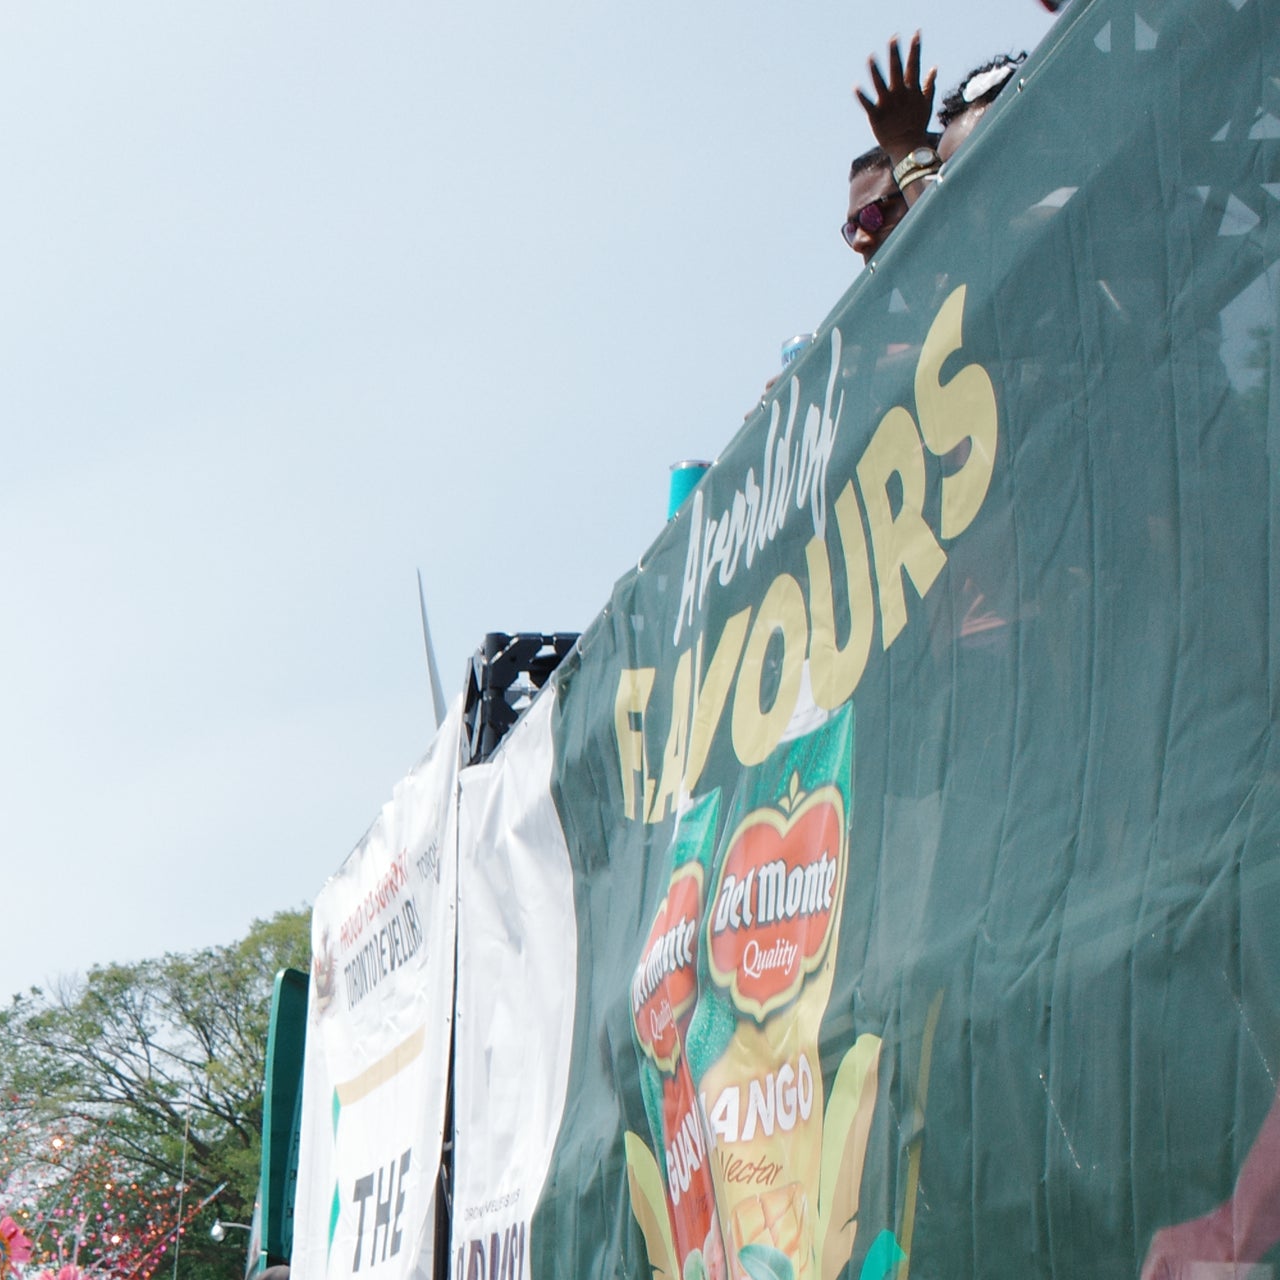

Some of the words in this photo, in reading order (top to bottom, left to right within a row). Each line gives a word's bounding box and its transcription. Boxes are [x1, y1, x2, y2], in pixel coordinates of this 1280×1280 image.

[615, 284, 998, 823] FLAVOURS
[714, 865, 753, 934] Del
[757, 851, 838, 925] Monte
[743, 939, 798, 980] Quality
[352, 1147, 411, 1273] THE
